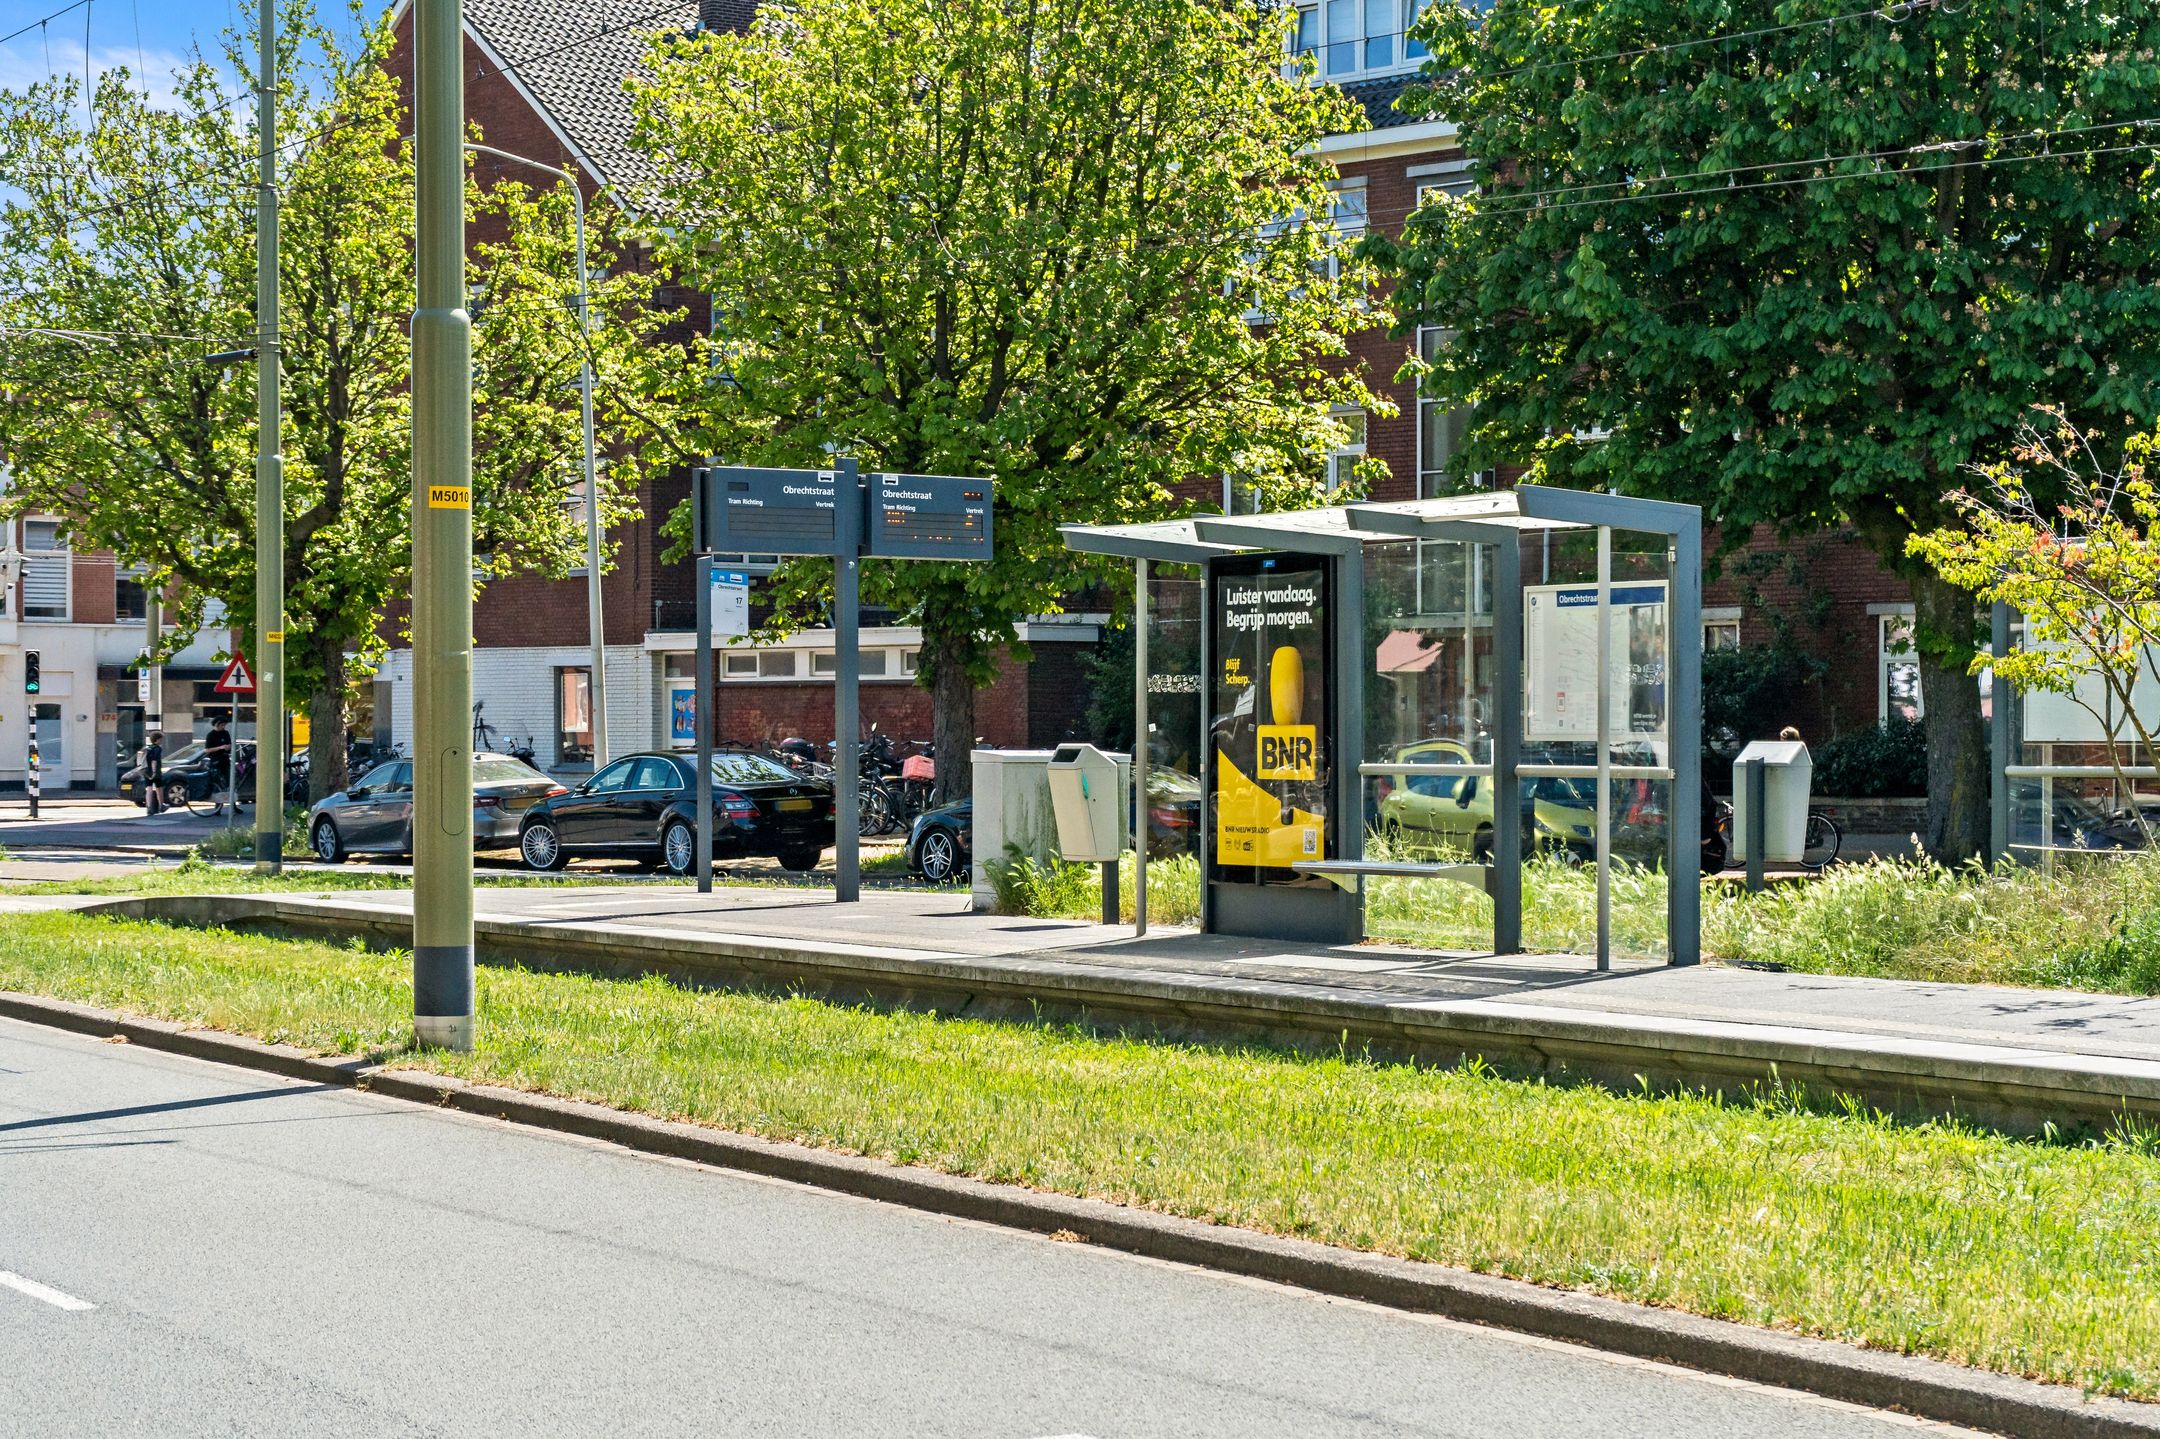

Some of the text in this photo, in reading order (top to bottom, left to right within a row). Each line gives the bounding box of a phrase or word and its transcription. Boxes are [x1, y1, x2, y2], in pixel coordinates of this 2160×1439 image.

[432, 490, 469, 503] M5010
[783, 485, 835, 496] Obrechtstraat
[882, 489, 932, 500] Obrechtstraat
[742, 498, 764, 507] Richting
[896, 504, 916, 513] Richting
[736, 597, 743, 605] 17
[1226, 584, 1317, 607] Luister vandaag.
[1226, 608, 1313, 632] Begrijp morgen.
[1225, 658, 1240, 672] Blijf
[1225, 673, 1250, 687] Scherp.
[1262, 736, 1312, 770] BNR
